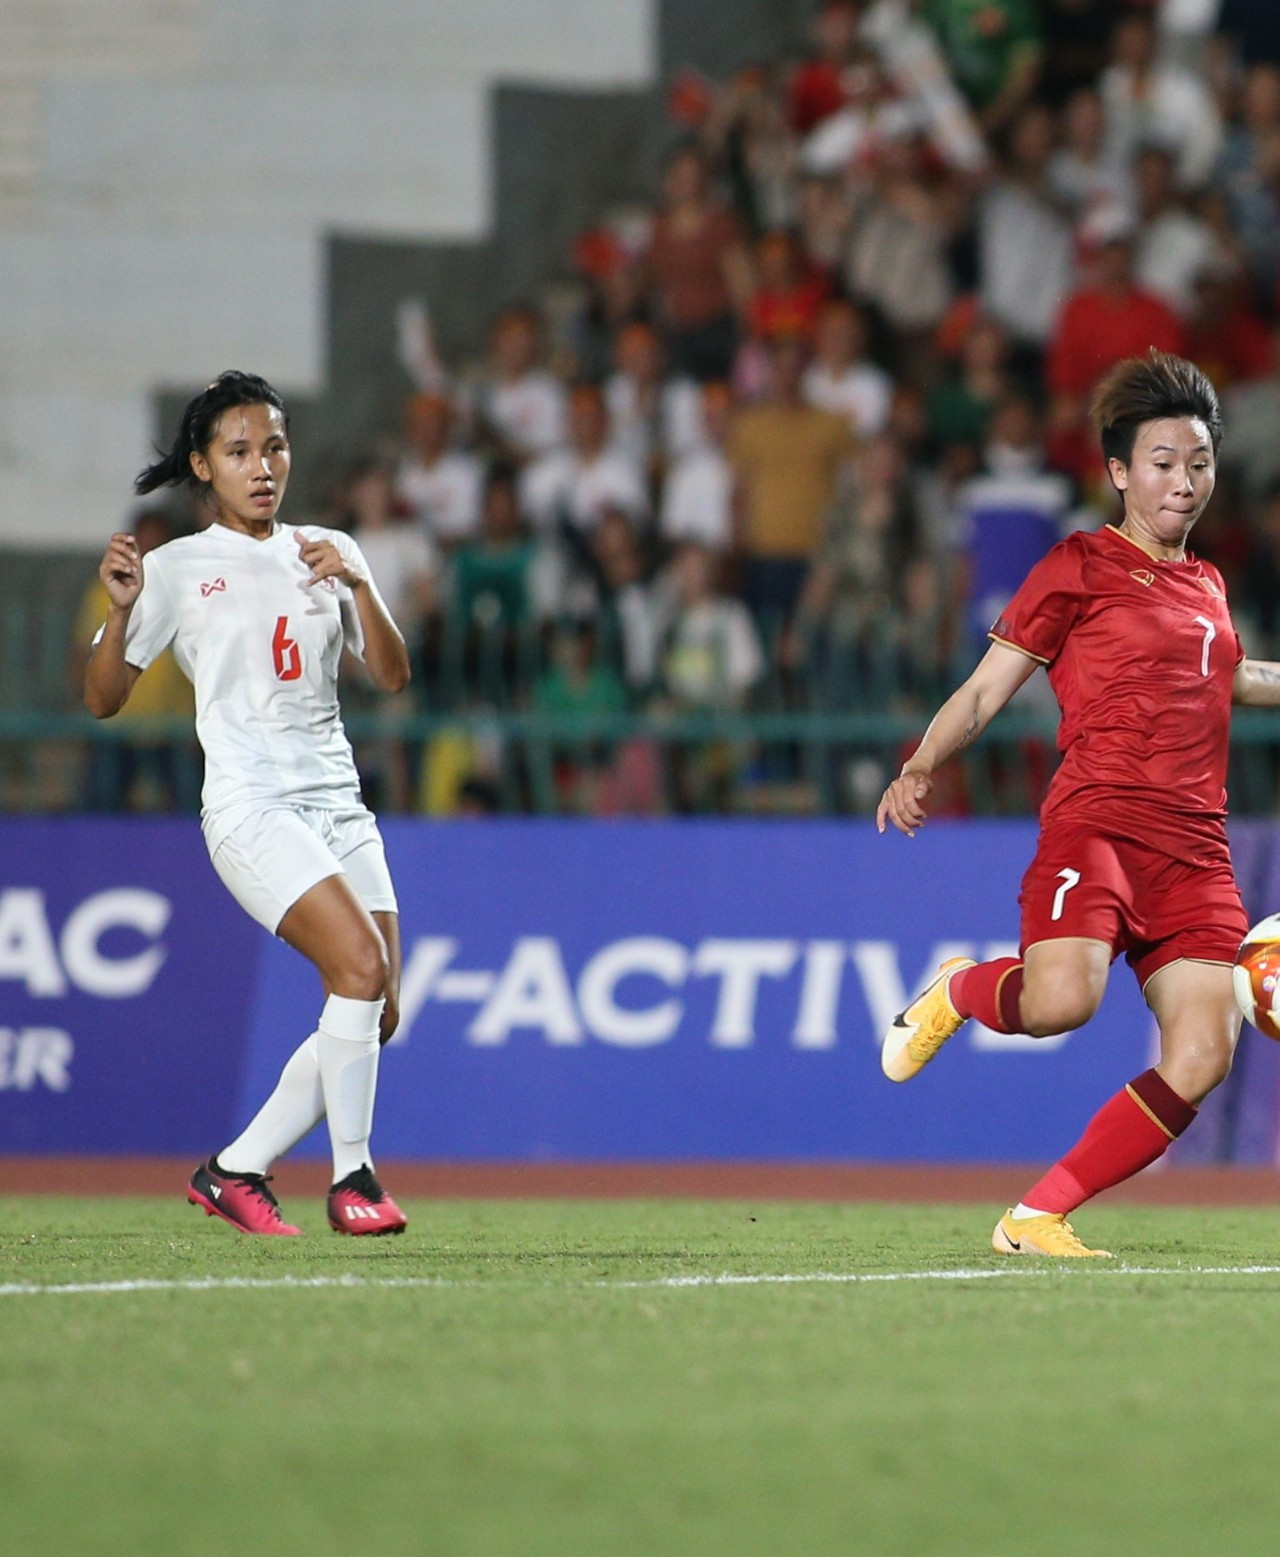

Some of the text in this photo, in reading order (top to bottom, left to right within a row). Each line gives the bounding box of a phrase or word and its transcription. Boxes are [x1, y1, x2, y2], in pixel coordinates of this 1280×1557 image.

[271, 616, 302, 681] 6
[1192, 615, 1217, 677] 7
[1050, 866, 1082, 921] 7
